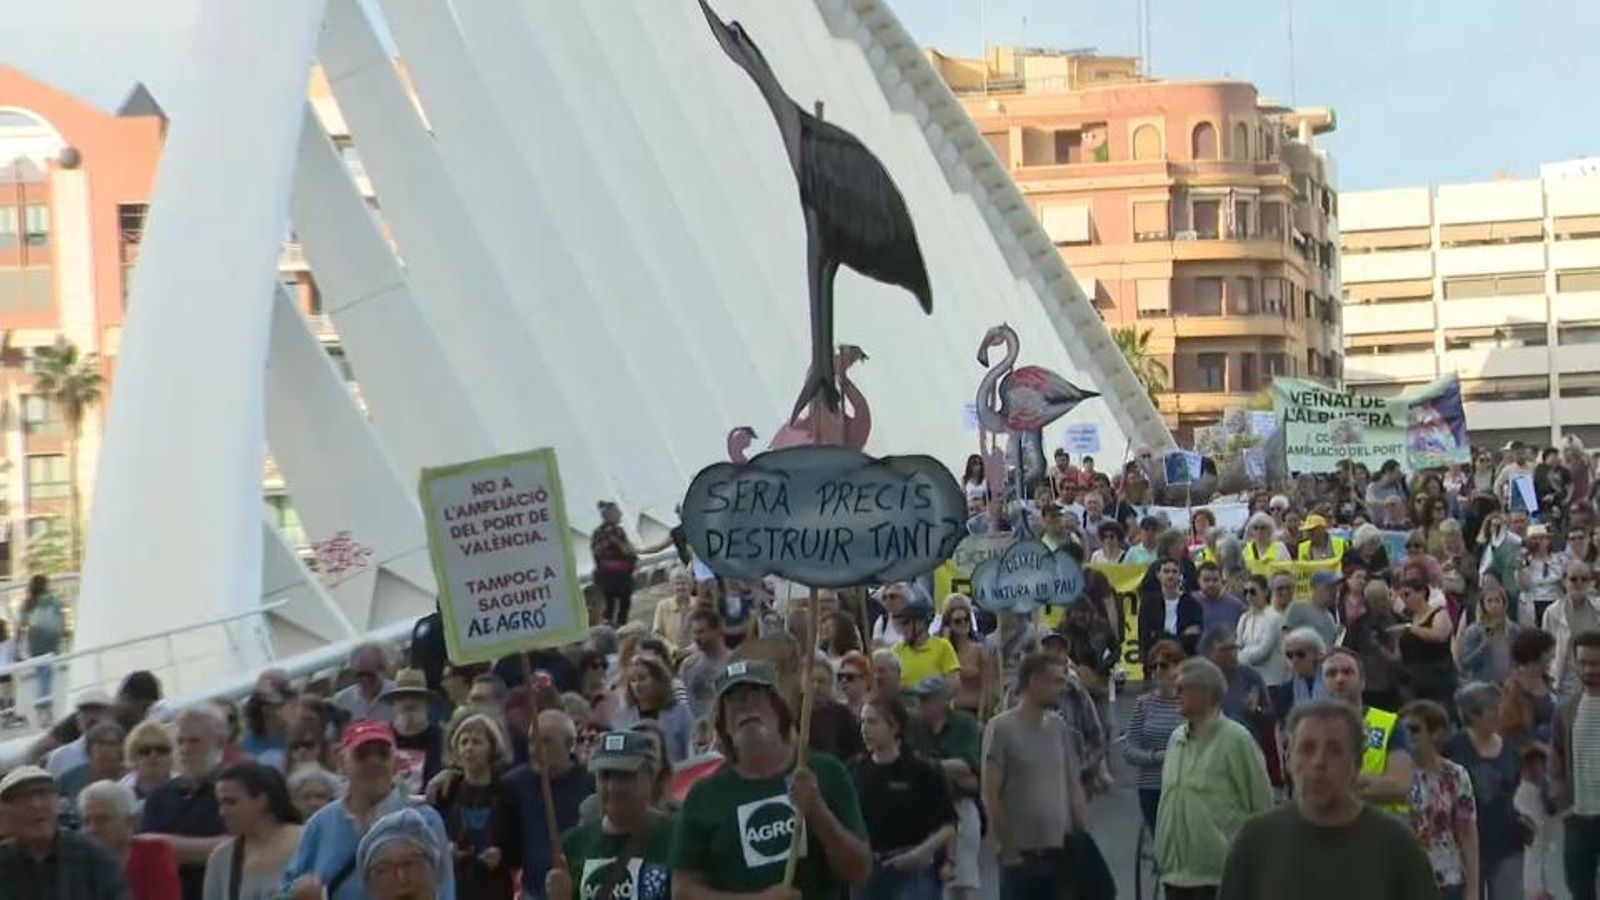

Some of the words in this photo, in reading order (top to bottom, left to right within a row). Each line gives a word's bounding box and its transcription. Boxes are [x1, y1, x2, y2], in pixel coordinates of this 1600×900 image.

[1289, 387, 1352, 409] VEÏNAT
[1360, 395, 1387, 409] DE
[1349, 446, 1370, 457] DEL
[472, 480, 496, 496] NO
[502, 477, 513, 491] A
[450, 522, 480, 539] DEL
[483, 512, 524, 532] PORT
[529, 508, 549, 524] DE
[706, 527, 853, 565] DESTRUIR
[869, 517, 958, 560] TANT?
[466, 568, 539, 595] TAMPOC
[544, 565, 556, 580] A
[991, 583, 1030, 599] NATURA
[1054, 578, 1077, 594] PAU
[479, 583, 551, 612] SAGUNT!
[496, 602, 547, 633] AGRÓ
